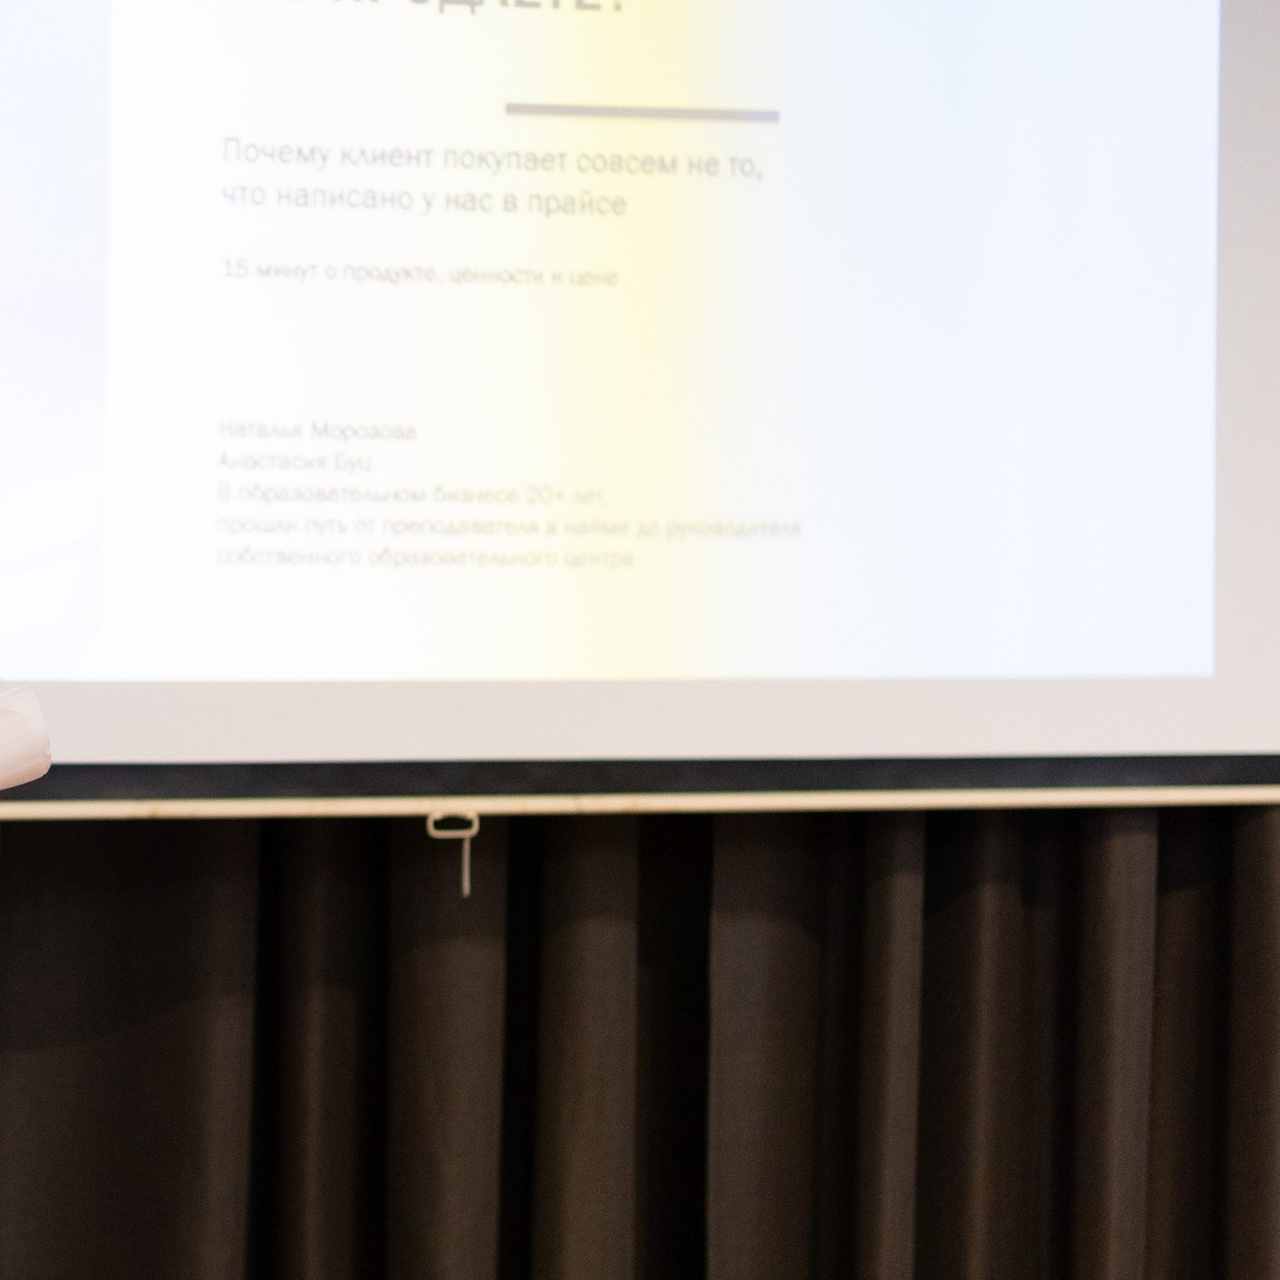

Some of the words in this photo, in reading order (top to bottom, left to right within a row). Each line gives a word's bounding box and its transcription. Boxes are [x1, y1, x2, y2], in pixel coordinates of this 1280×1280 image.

[222, 136, 331, 170] Почему
[340, 146, 435, 169] клиент
[442, 149, 568, 176] покупает
[576, 153, 678, 178] совсем
[687, 157, 720, 178] не
[729, 157, 763, 181] то,
[222, 186, 267, 206] что
[276, 188, 414, 210] написано
[421, 194, 434, 216] у
[444, 194, 494, 213] нас
[503, 196, 519, 213] в
[526, 188, 628, 218] прайсе
[256, 263, 317, 282] минут
[551, 270, 563, 285] и
